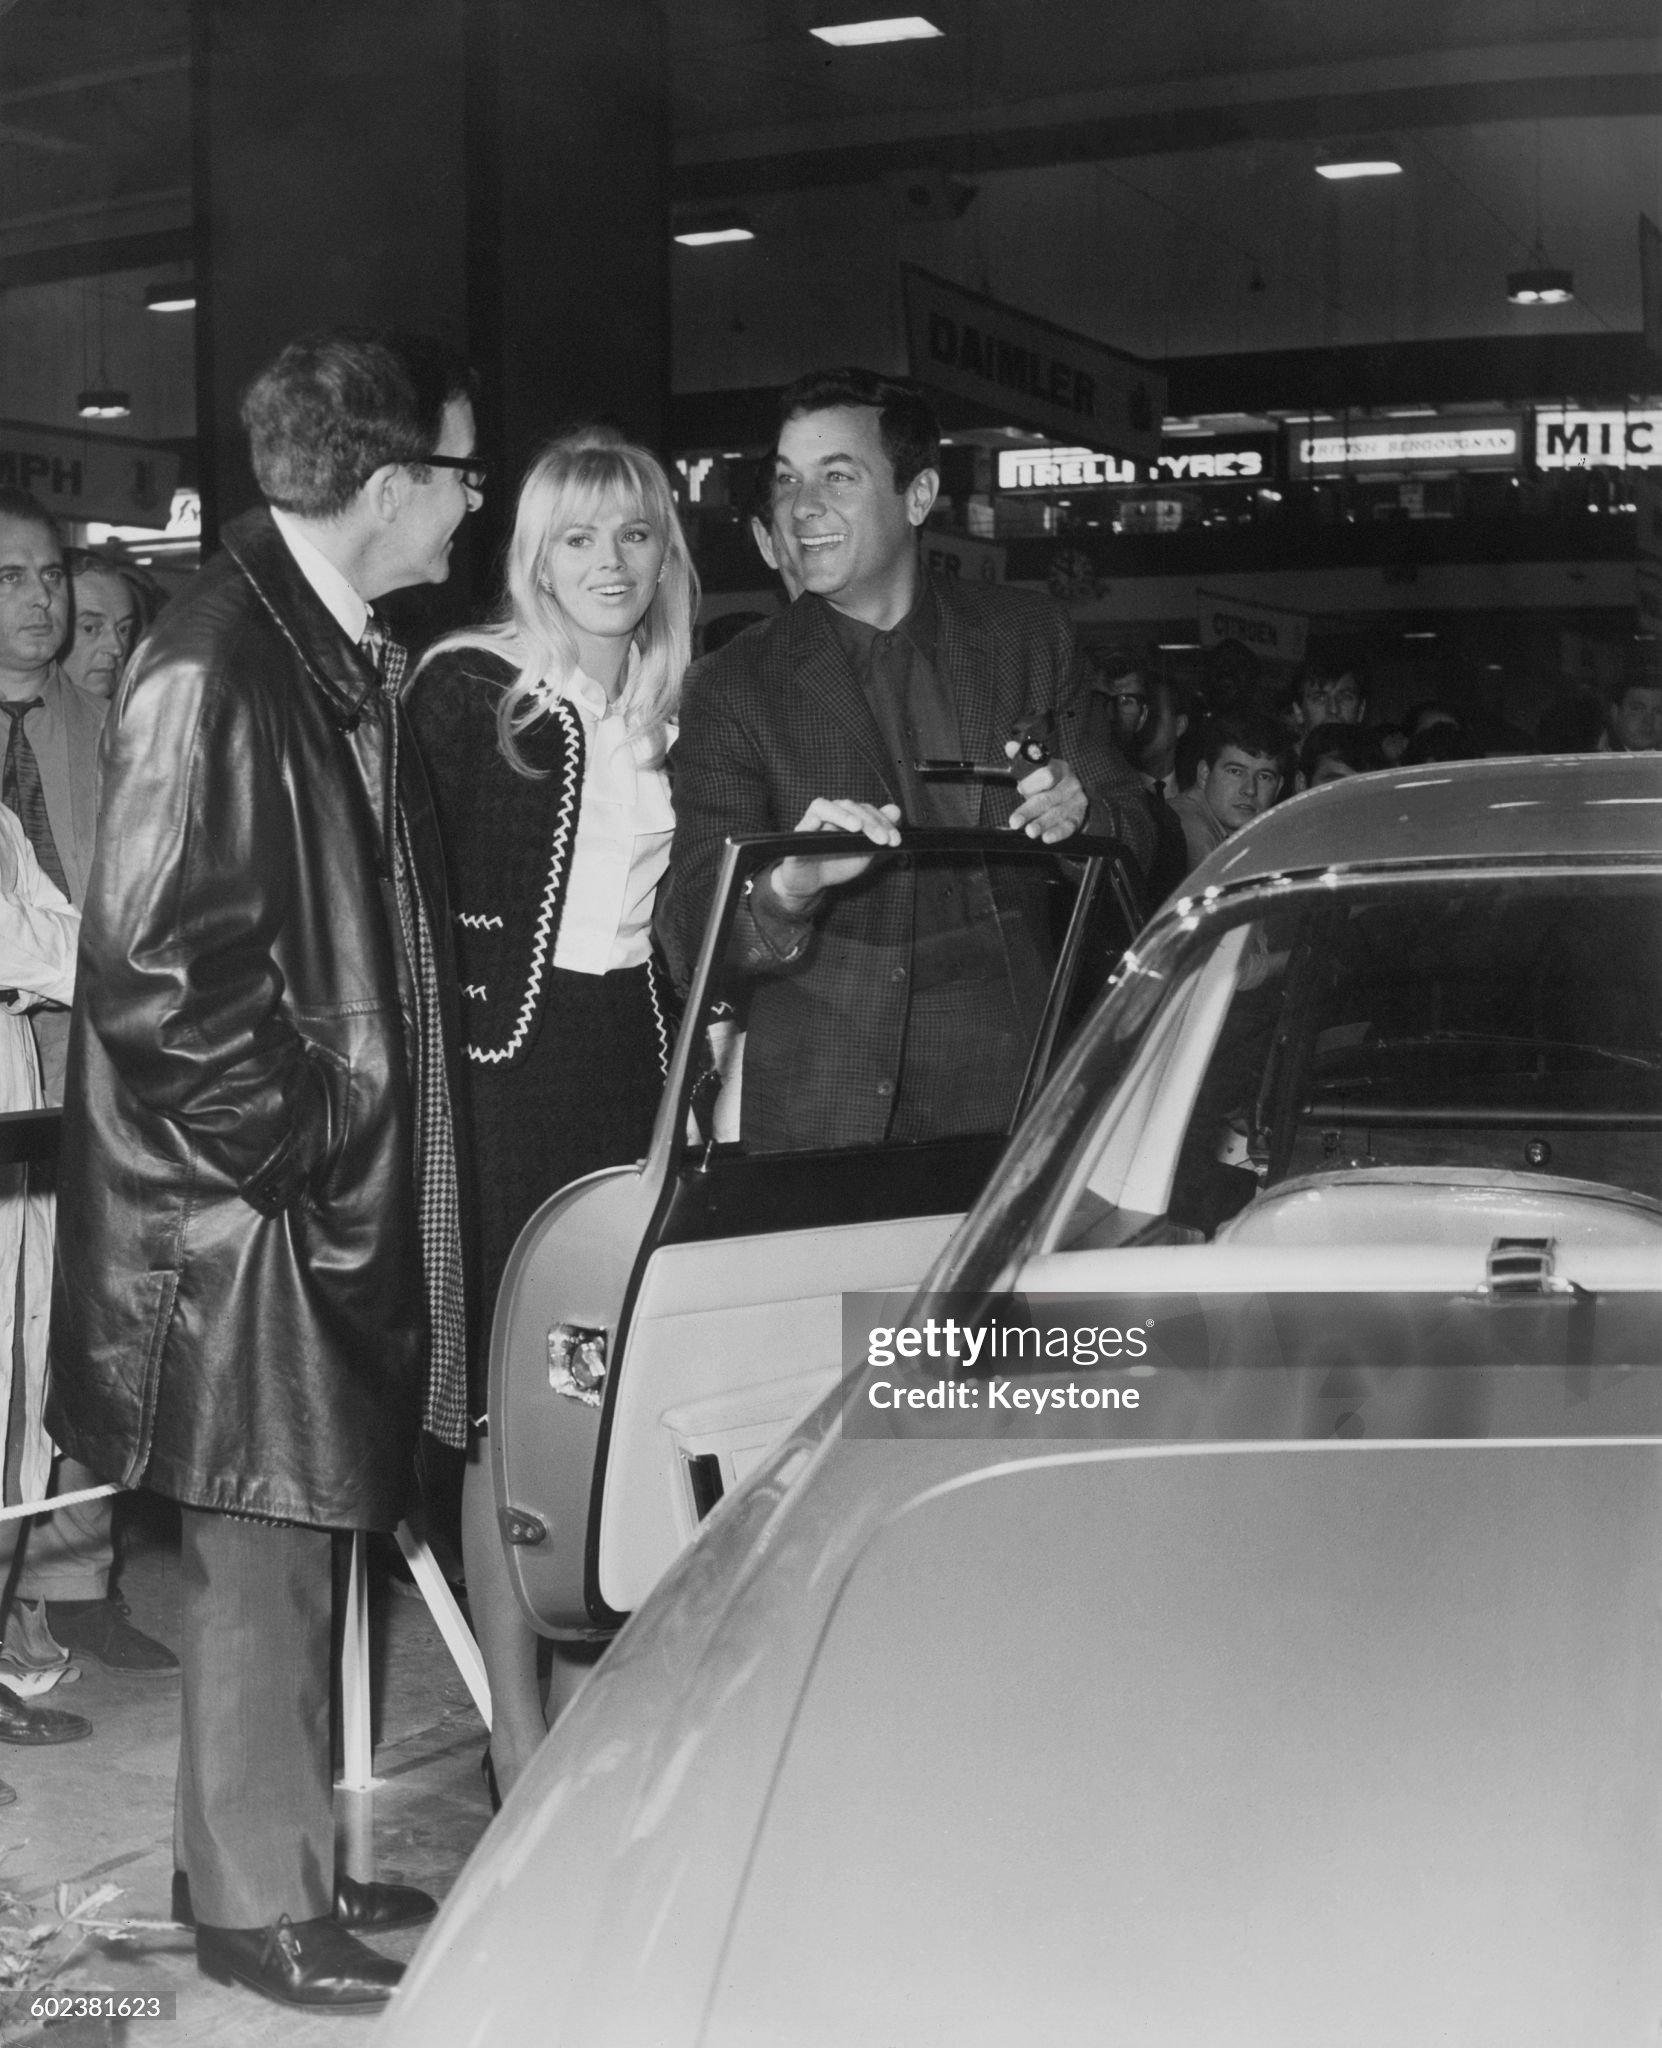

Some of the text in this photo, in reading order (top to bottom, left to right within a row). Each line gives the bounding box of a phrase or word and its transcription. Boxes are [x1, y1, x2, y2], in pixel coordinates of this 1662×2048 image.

[929, 311, 1095, 417] DAIMLER
[1306, 440, 1378, 457] RITSH
[1547, 422, 1654, 454] MIC
[999, 447, 1136, 488] PIRELLI
